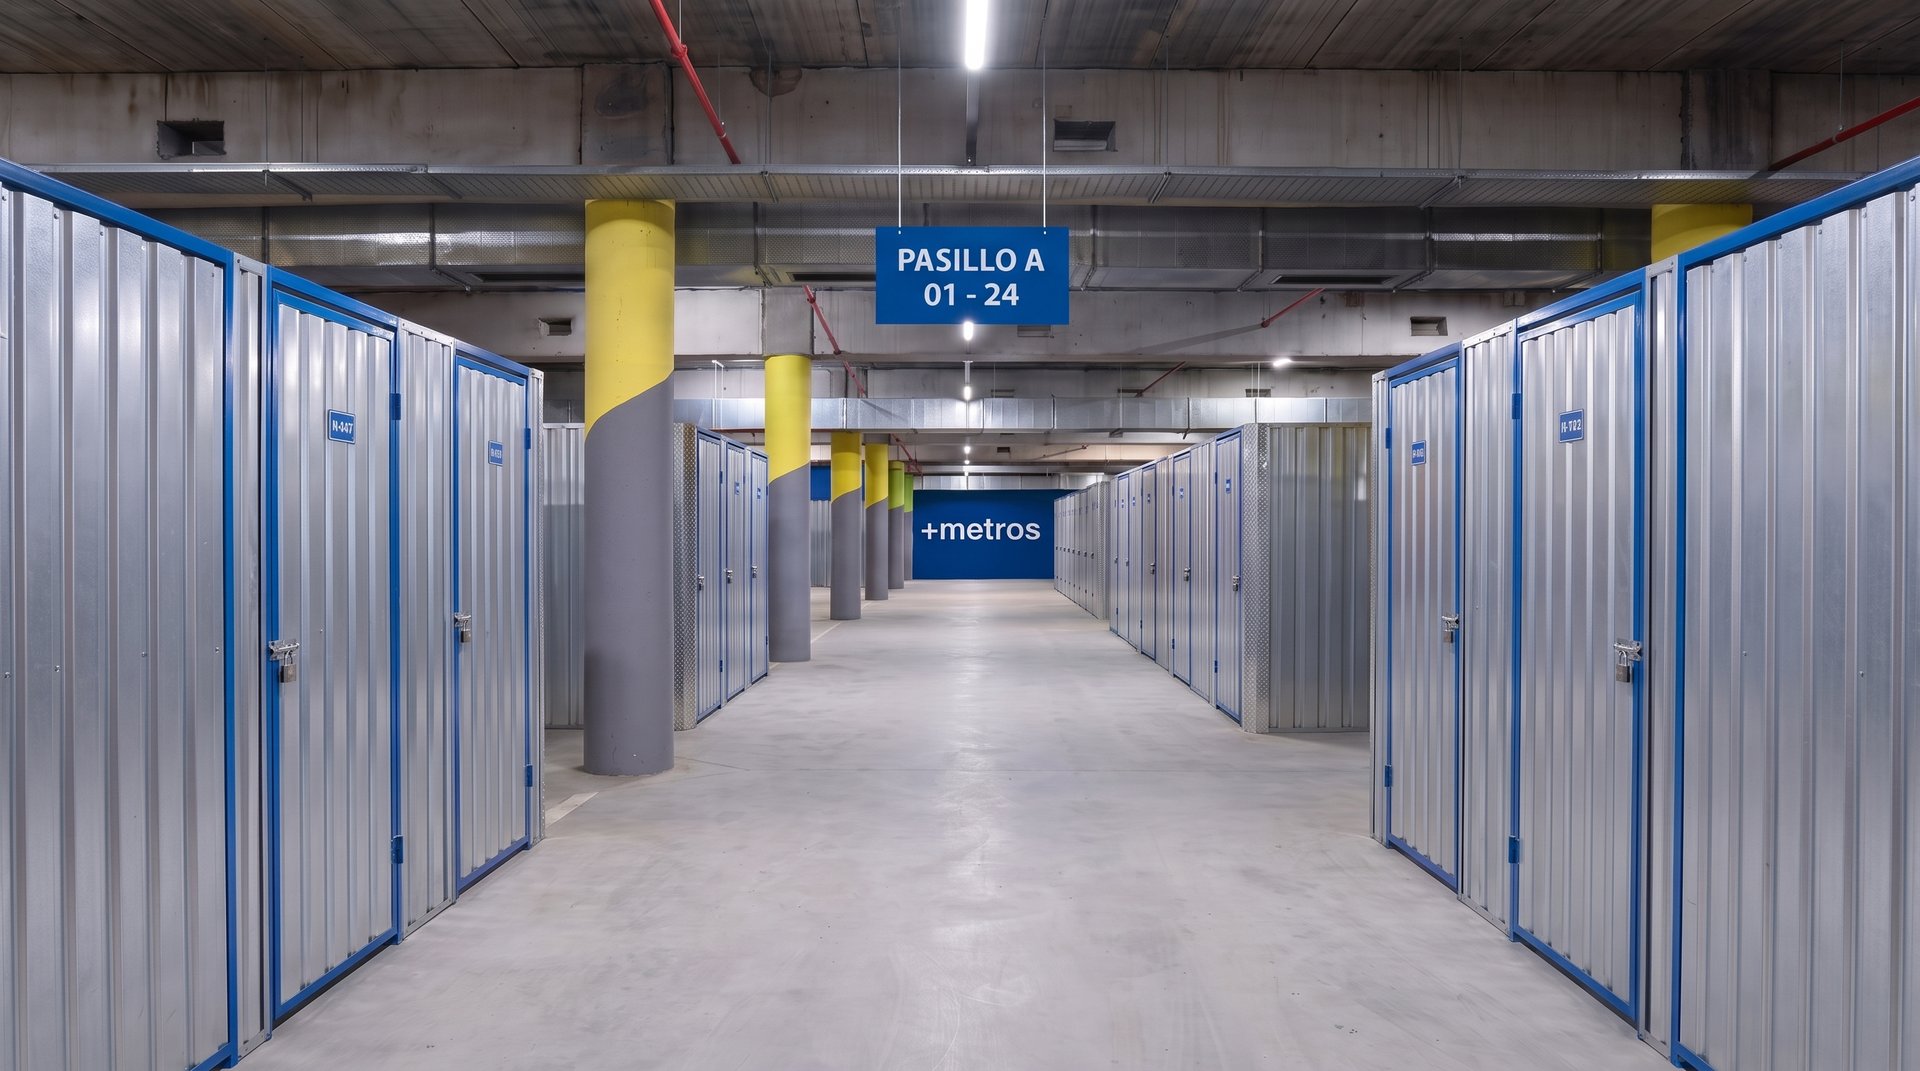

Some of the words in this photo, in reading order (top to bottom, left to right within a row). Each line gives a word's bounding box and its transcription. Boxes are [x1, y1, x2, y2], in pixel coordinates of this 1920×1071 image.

[898, 248, 1017, 272] PASILLO
[1024, 248, 1045, 272] A
[924, 282, 955, 306] 01
[984, 282, 1019, 306] 24
[921, 518, 1041, 541] +metros
